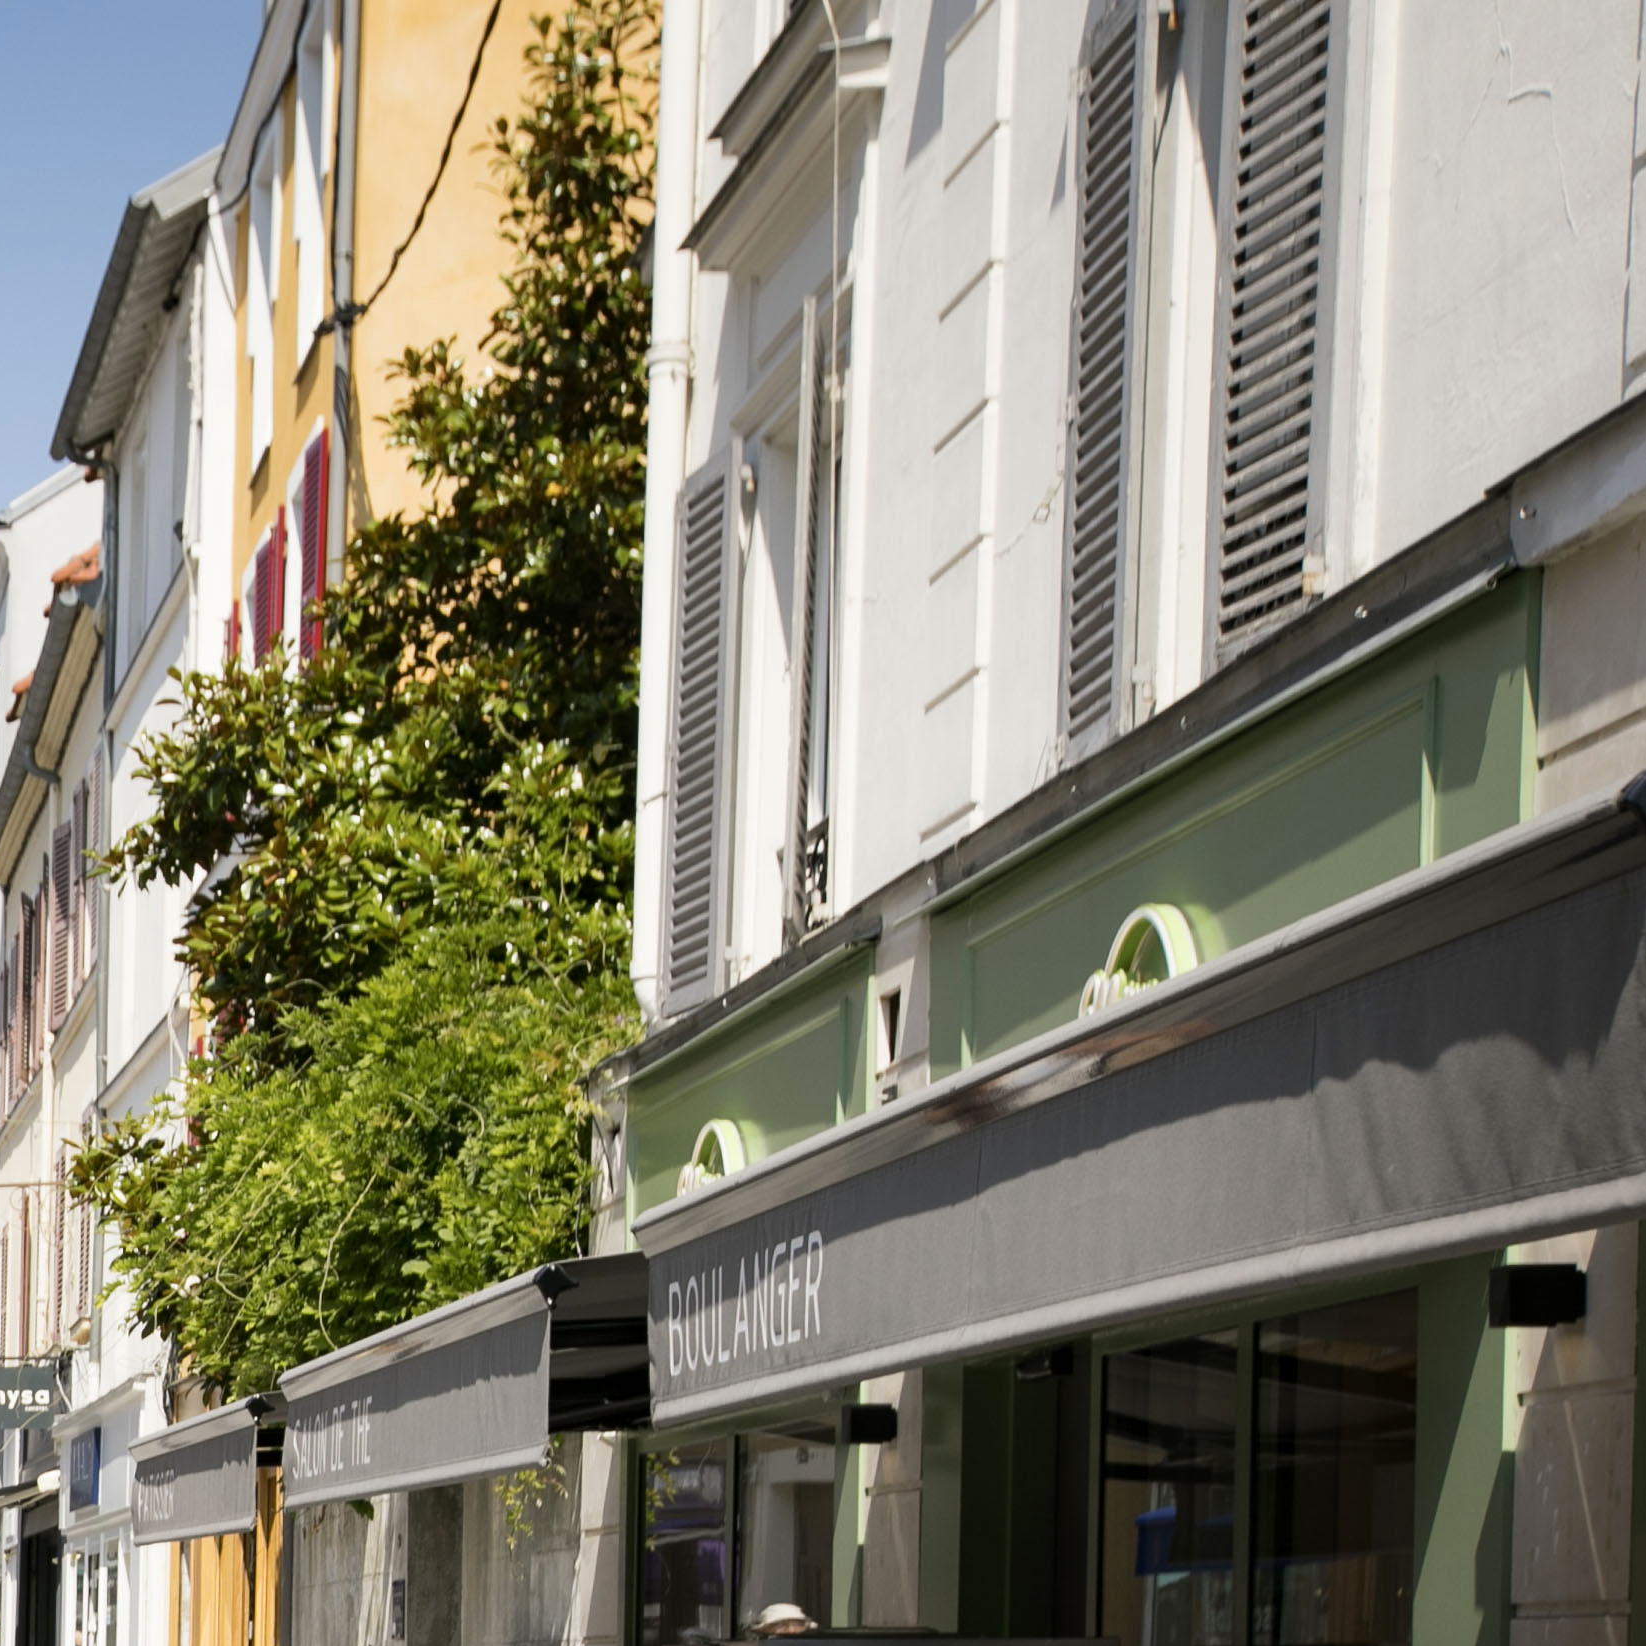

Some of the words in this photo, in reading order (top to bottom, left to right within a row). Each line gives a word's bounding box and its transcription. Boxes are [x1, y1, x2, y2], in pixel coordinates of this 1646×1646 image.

[668, 1229, 824, 1377] BOULANGER
[292, 1410, 328, 1480] SALON
[330, 1404, 346, 1472] DE
[351, 1395, 373, 1467] THE
